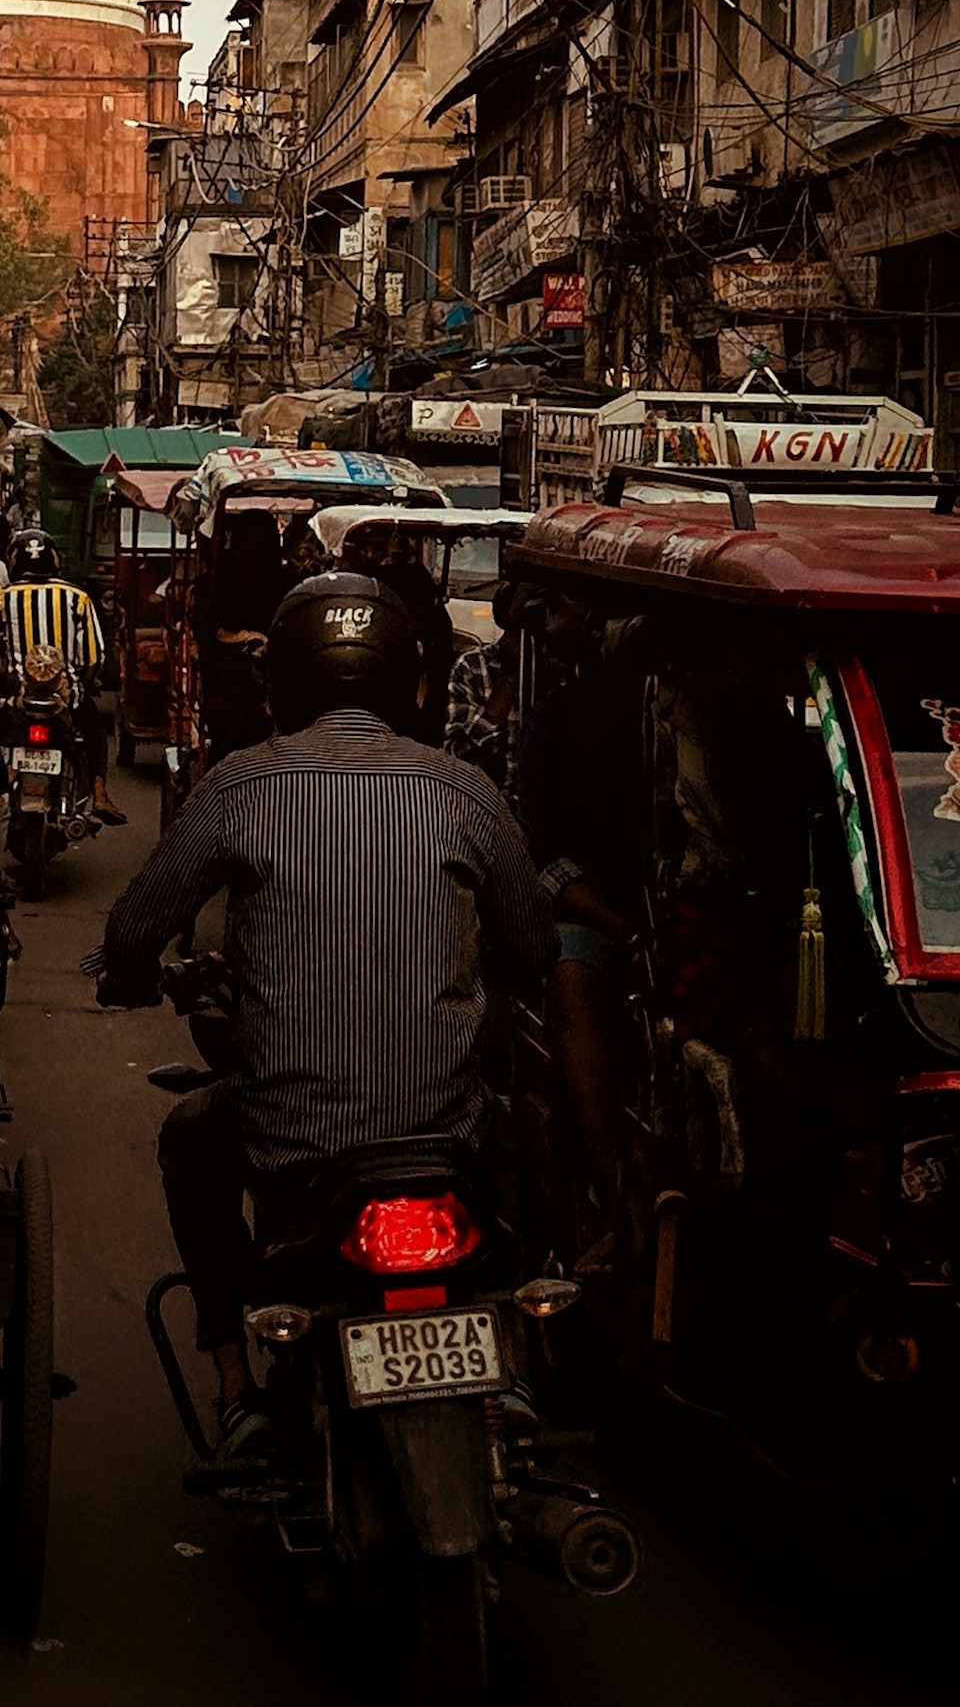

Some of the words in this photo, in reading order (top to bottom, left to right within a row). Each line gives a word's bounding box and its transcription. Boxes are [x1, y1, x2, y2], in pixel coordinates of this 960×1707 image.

[751, 430, 848, 463] KGN
[324, 606, 374, 623] BLACK
[376, 1317, 481, 1355] HR02A
[384, 1349, 487, 1387] S2039
